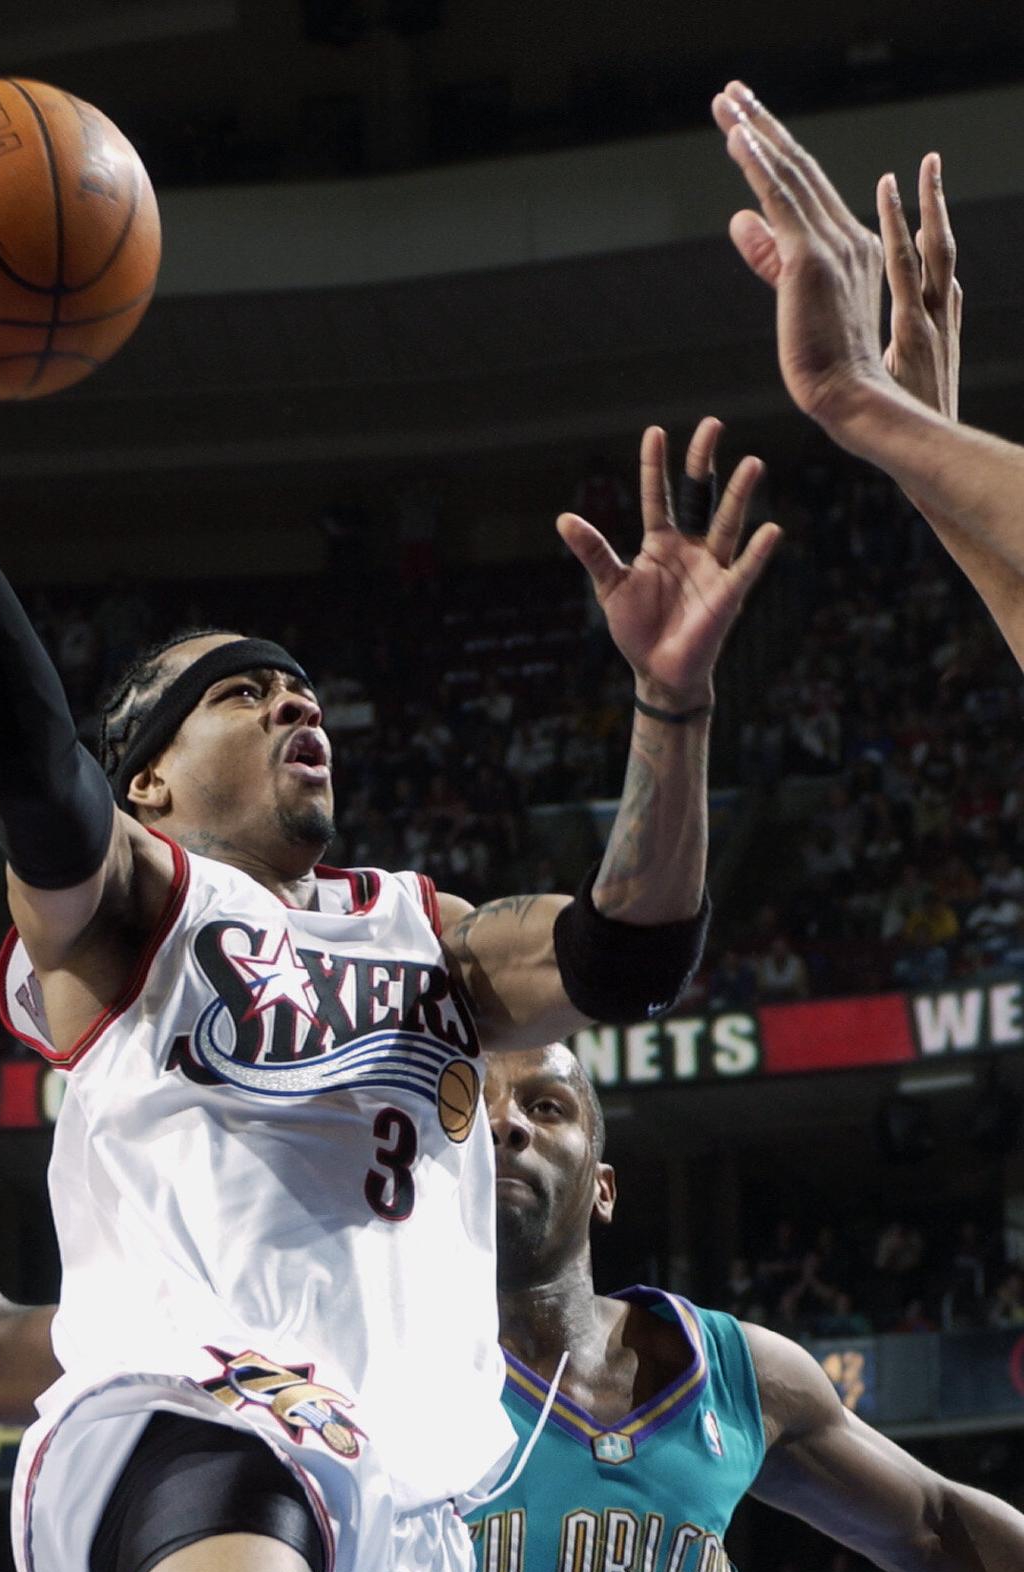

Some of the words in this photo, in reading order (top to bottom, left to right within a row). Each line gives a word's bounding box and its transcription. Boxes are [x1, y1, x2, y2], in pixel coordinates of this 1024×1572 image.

[165, 920, 480, 1085] SIXERS
[576, 1013, 760, 1086] NETS
[364, 1106, 418, 1222] 3
